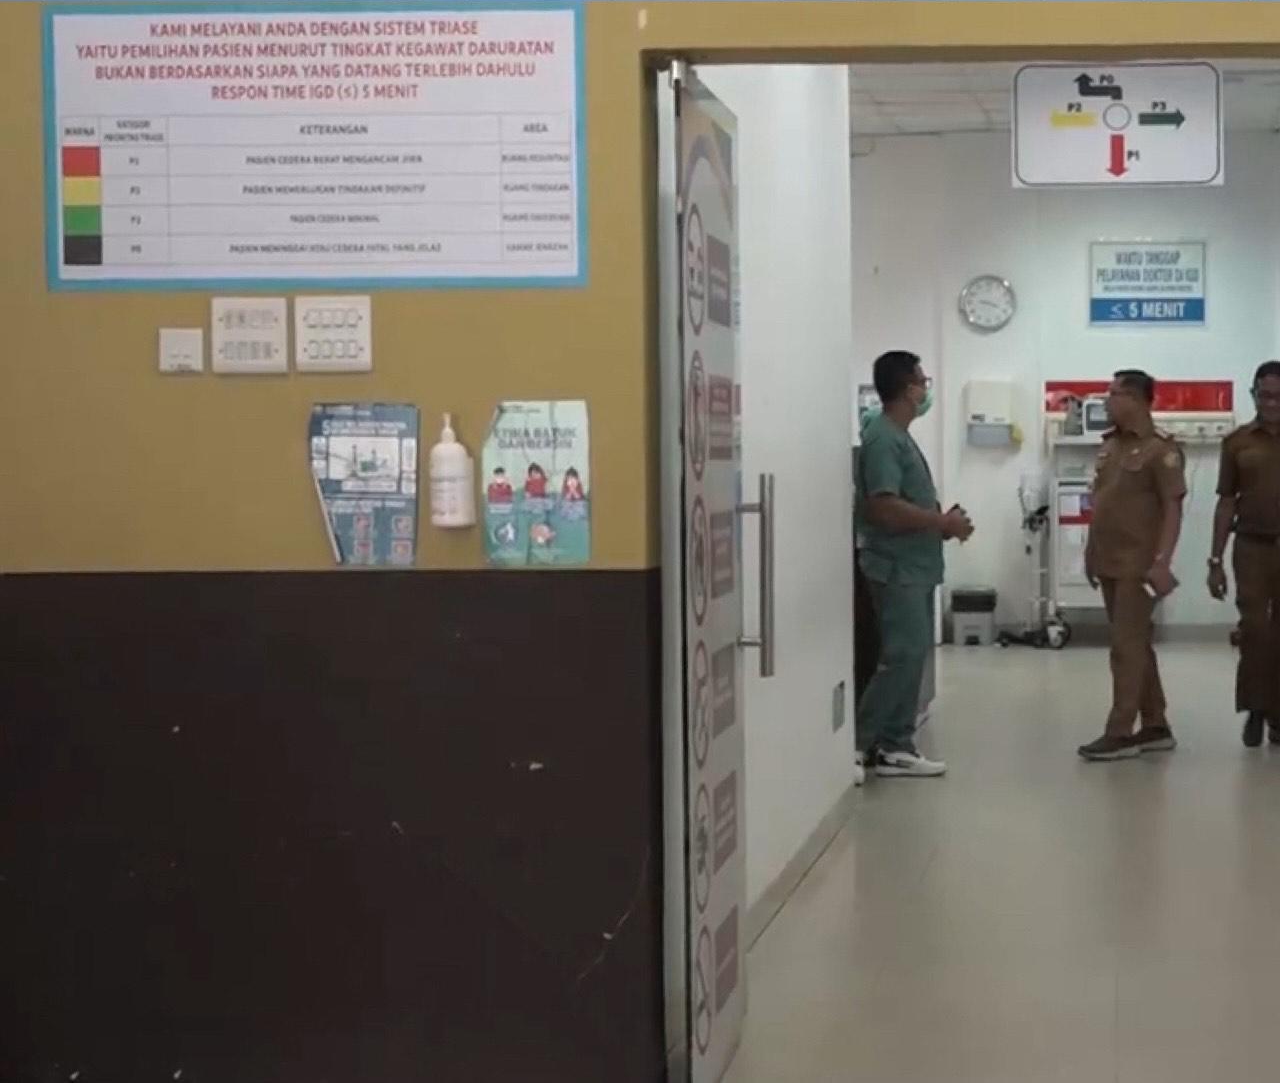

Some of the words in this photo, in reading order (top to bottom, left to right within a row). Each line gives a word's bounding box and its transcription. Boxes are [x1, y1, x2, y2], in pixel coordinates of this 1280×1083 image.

[150, 23, 187, 37] KAMI
[190, 22, 262, 36] MELAYANI
[265, 22, 308, 36] ANDA
[311, 21, 370, 36] DENGAN
[374, 21, 425, 35] SISTEM
[430, 20, 479, 35] TRIASE
[76, 44, 118, 59] YAITU
[121, 44, 200, 58] PEMILIHAN
[203, 44, 252, 58] PASIEN
[256, 43, 327, 57] MENURUT
[331, 42, 393, 57] TINGKAT
[397, 42, 464, 56] KEGAWAT
[468, 41, 555, 56] DARURATAN
[95, 66, 145, 80] BUKAN
[149, 64, 253, 79] BERDASARKAN
[257, 64, 298, 78] SIAPA
[302, 64, 341, 78] YANG
[344, 64, 401, 78] DATANG
[405, 63, 473, 77] TERLEBIH
[476, 62, 536, 77] DAHULU
[1100, 74, 1115, 85] P0
[212, 85, 268, 100] RESPON
[272, 85, 306, 99] TIME
[310, 84, 334, 99] IGD
[374, 84, 419, 99] MENIT
[1067, 102, 1082, 113] P2
[1151, 101, 1167, 111] P3
[299, 124, 368, 135] KETERANGAN
[1127, 149, 1140, 161] P1
[1142, 301, 1186, 318] MENIT
